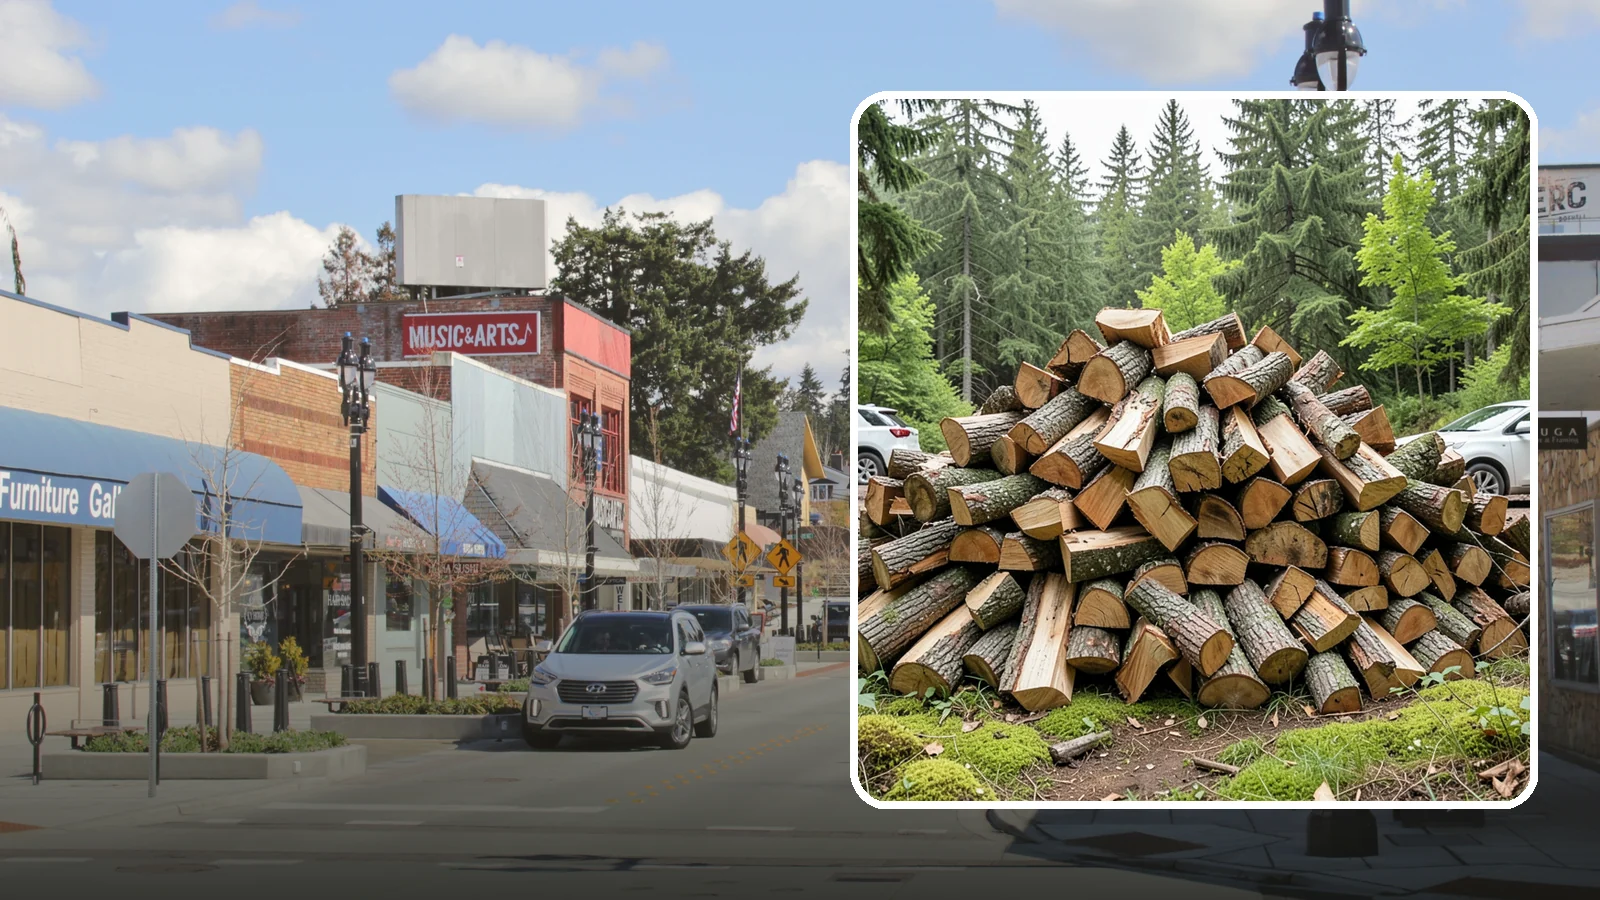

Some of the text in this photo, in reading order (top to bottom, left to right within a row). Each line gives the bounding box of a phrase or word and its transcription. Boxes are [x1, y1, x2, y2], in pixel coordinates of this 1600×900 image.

[409, 323, 519, 349] MUSIC&ARTS
[1540, 427, 1577, 436] UGA
[0, 471, 121, 519] Furniture Gal
[453, 563, 479, 575] SUSHI
